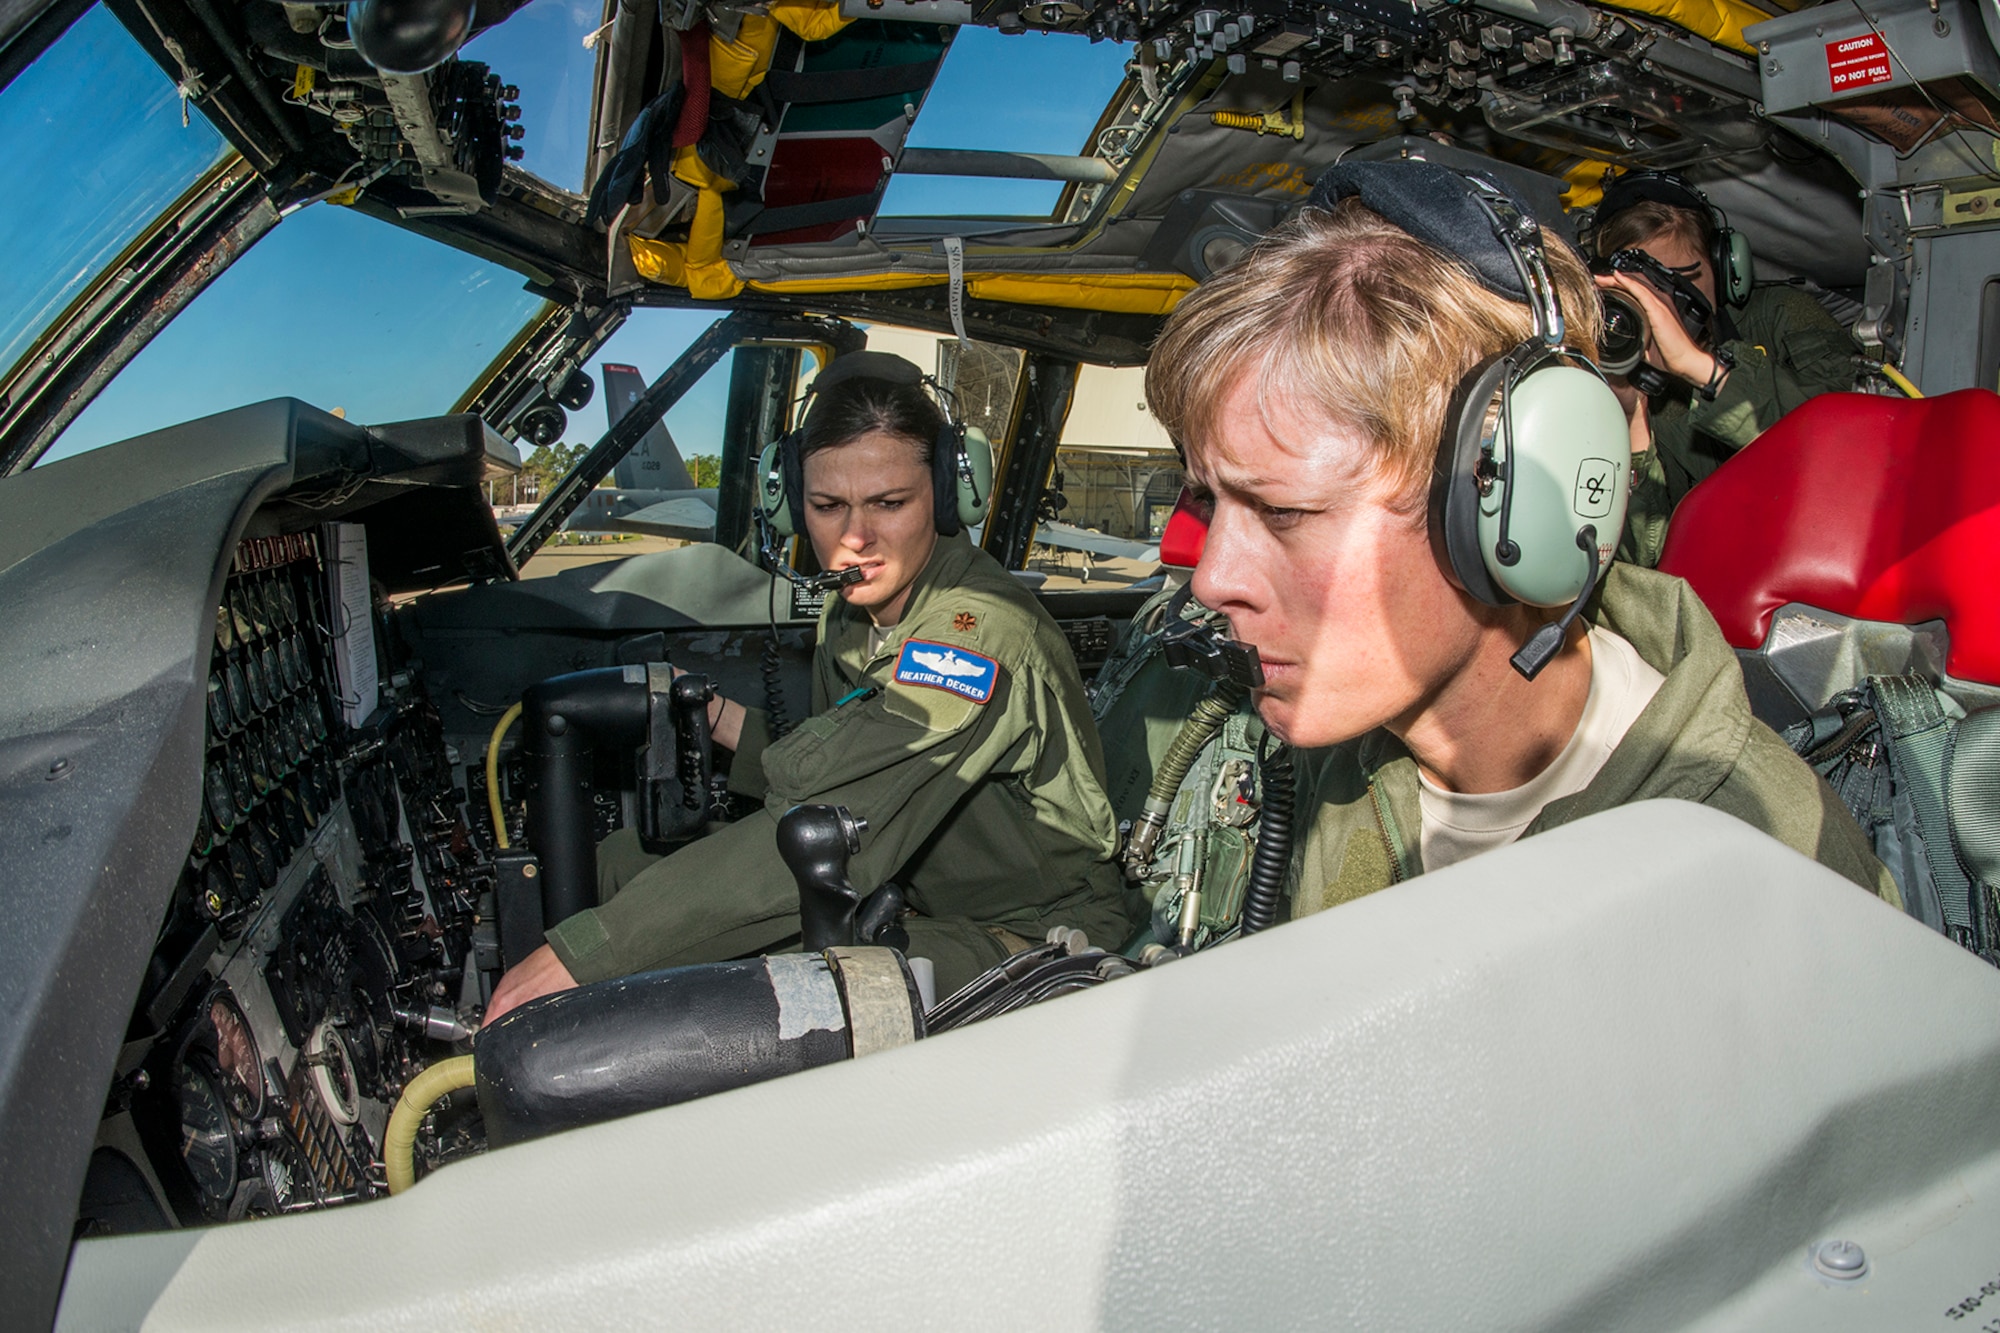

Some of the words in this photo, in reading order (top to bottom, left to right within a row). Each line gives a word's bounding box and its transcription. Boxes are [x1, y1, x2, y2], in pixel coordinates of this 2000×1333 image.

[1838, 37, 1874, 52] CAUTION
[1833, 73, 1847, 84] DO
[1848, 69, 1866, 81] NOT
[1868, 65, 1887, 77] PULL
[951, 278, 961, 321] SHADE
[900, 670, 935, 684] HEATHER
[946, 678, 986, 699] DECKER
